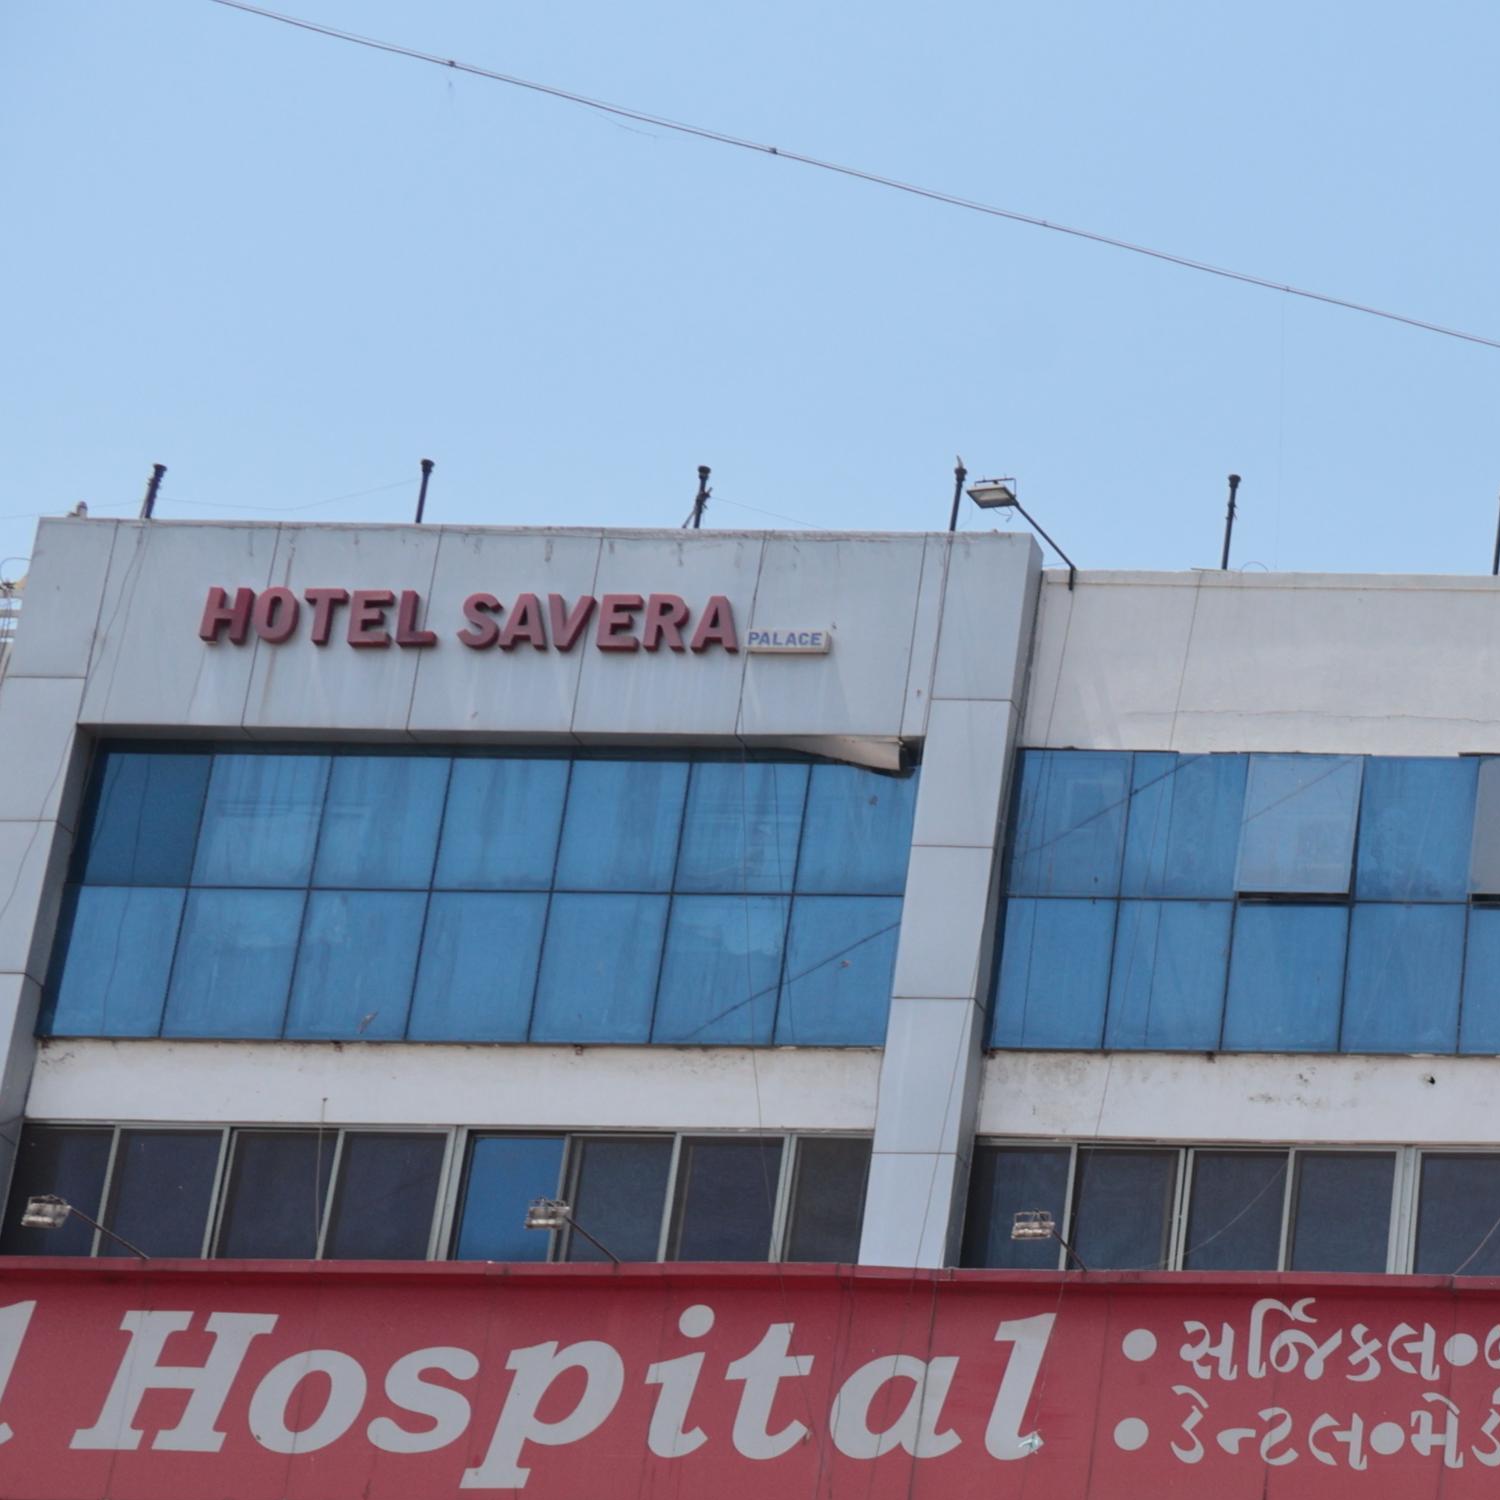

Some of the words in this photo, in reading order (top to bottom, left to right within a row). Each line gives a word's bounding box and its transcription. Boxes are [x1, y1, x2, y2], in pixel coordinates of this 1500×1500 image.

[199, 585, 438, 650] HOTEL
[456, 591, 740, 655] SAVERA
[746, 628, 824, 649] PALACE
[68, 1302, 1057, 1490] Hospital
